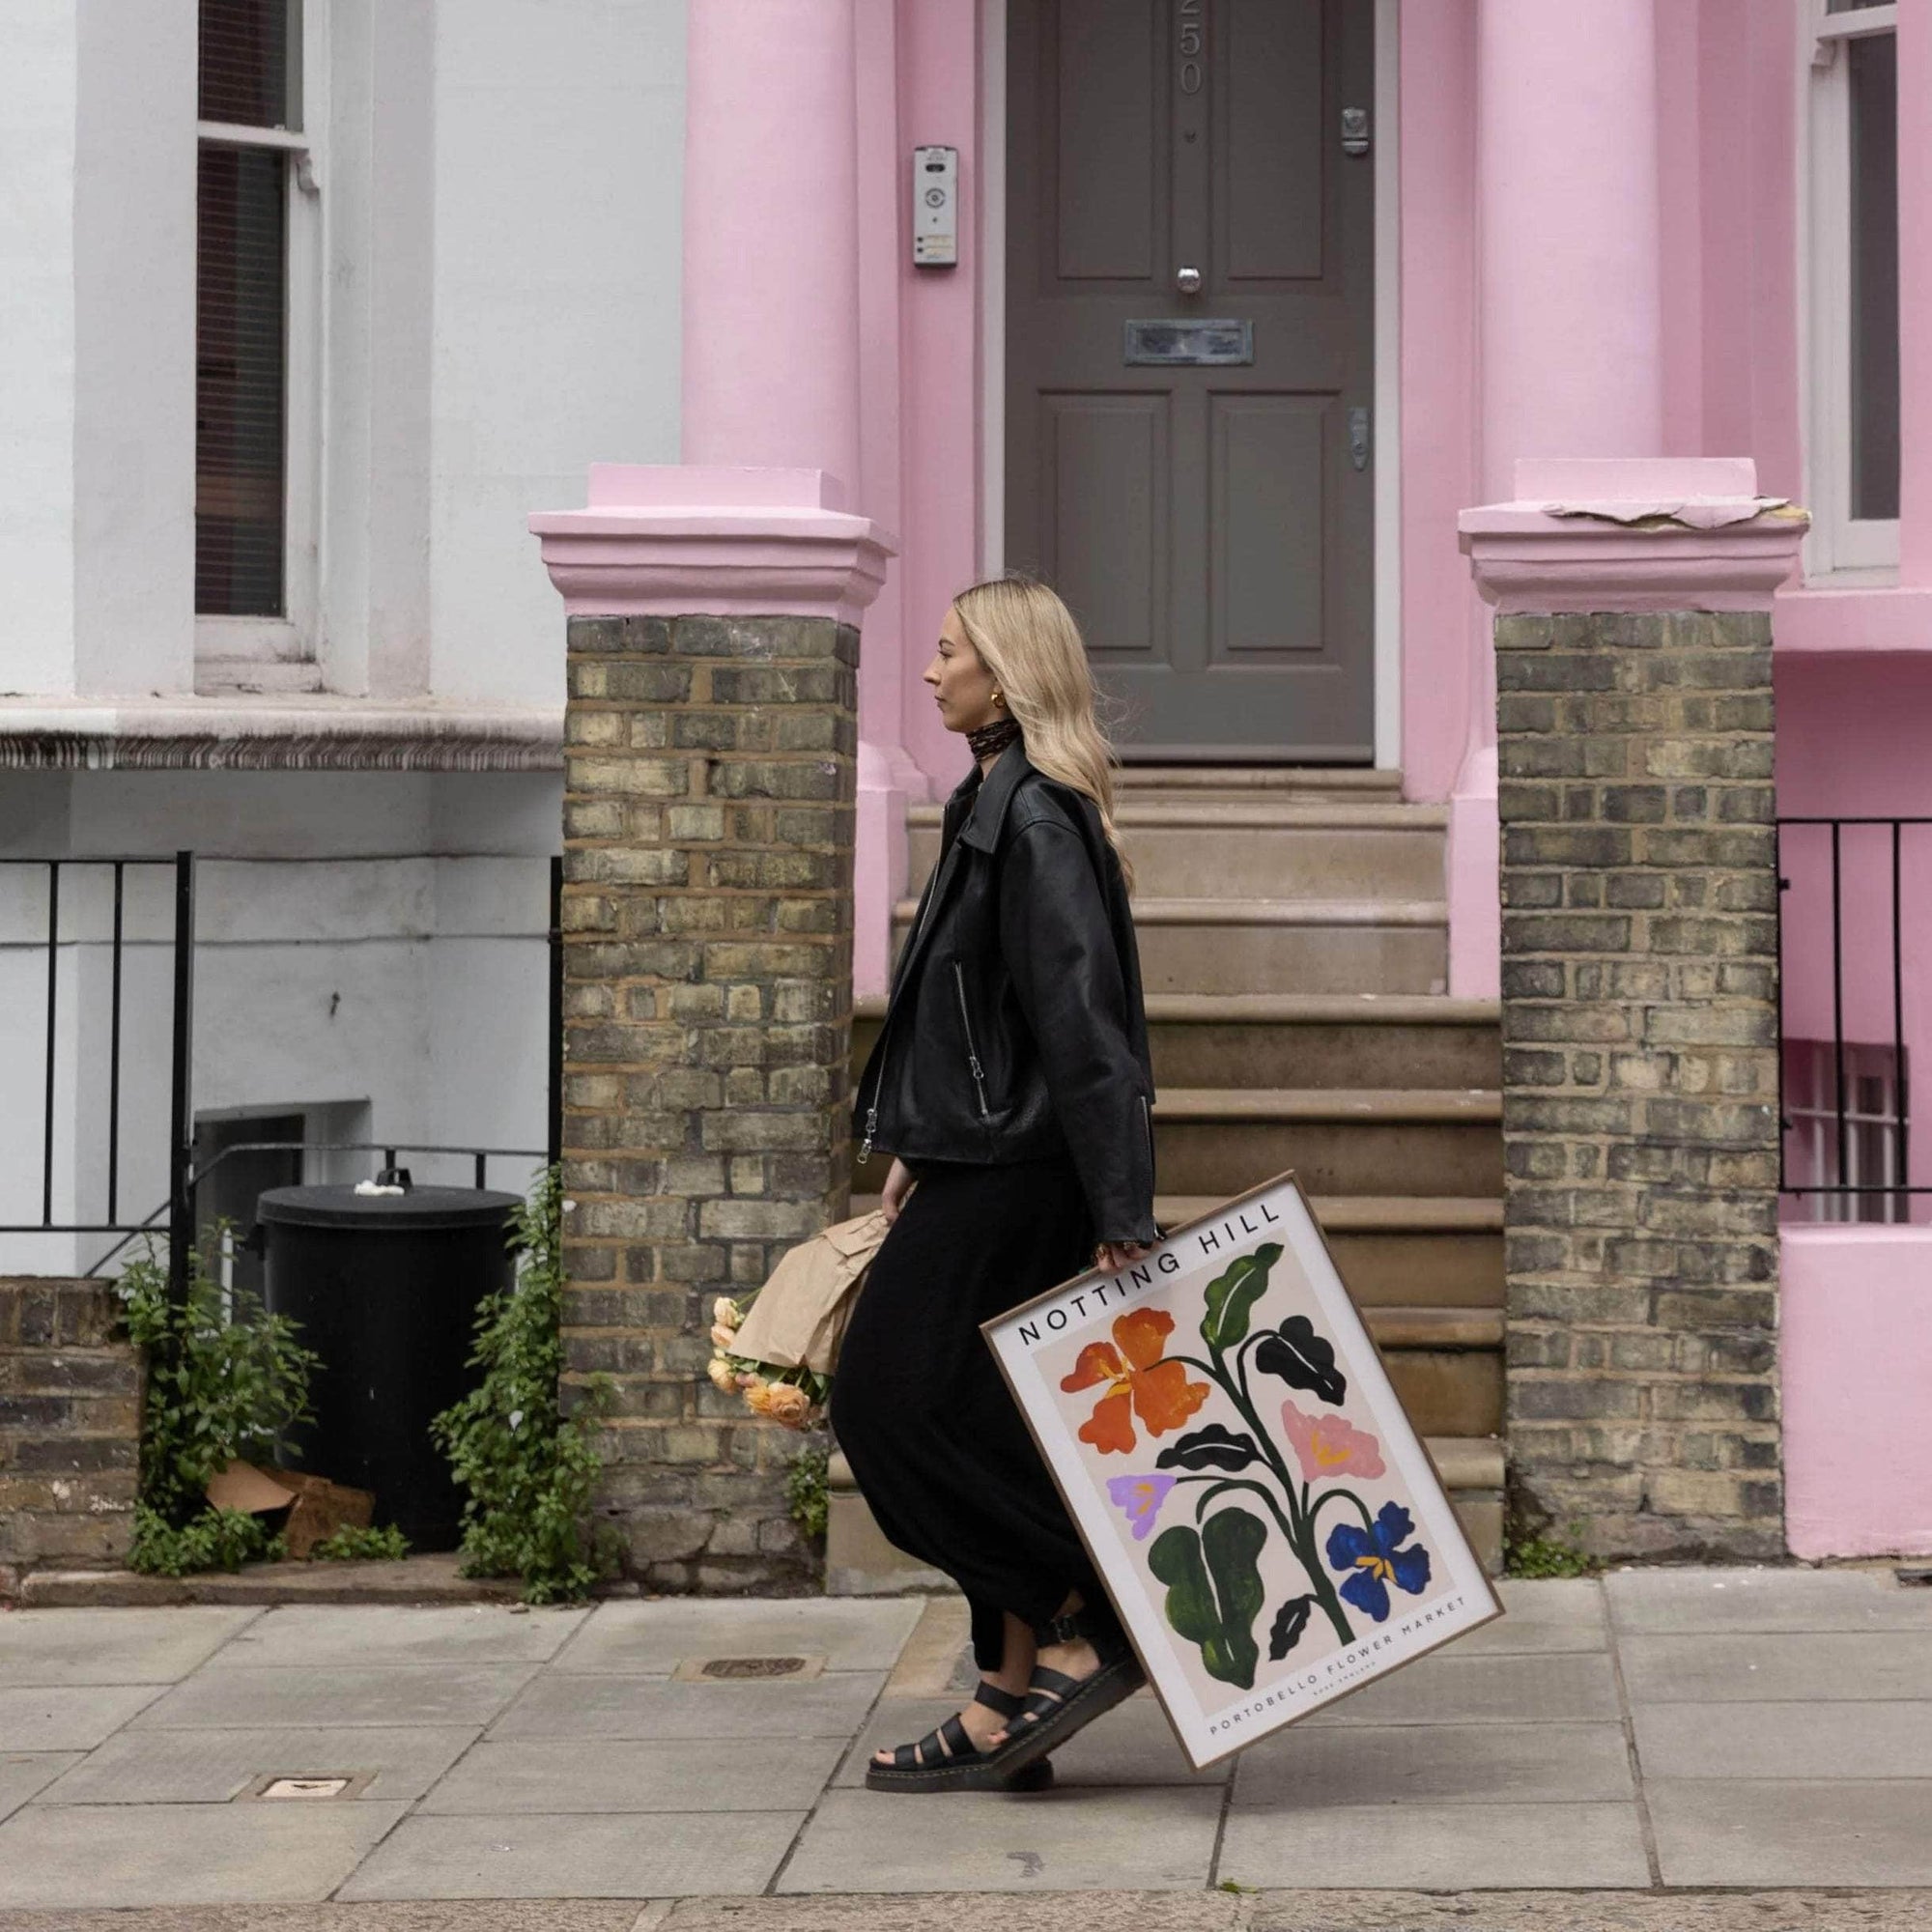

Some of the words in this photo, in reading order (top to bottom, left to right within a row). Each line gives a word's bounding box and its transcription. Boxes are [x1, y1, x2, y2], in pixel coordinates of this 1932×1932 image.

[1018, 1253, 1180, 1345] NOTTING
[1198, 1205, 1279, 1254] HILL
[1209, 1674, 1318, 1735] PORTOBELLO
[1326, 1634, 1393, 1675] FLOWER
[1402, 1597, 1465, 1634] MARKET
